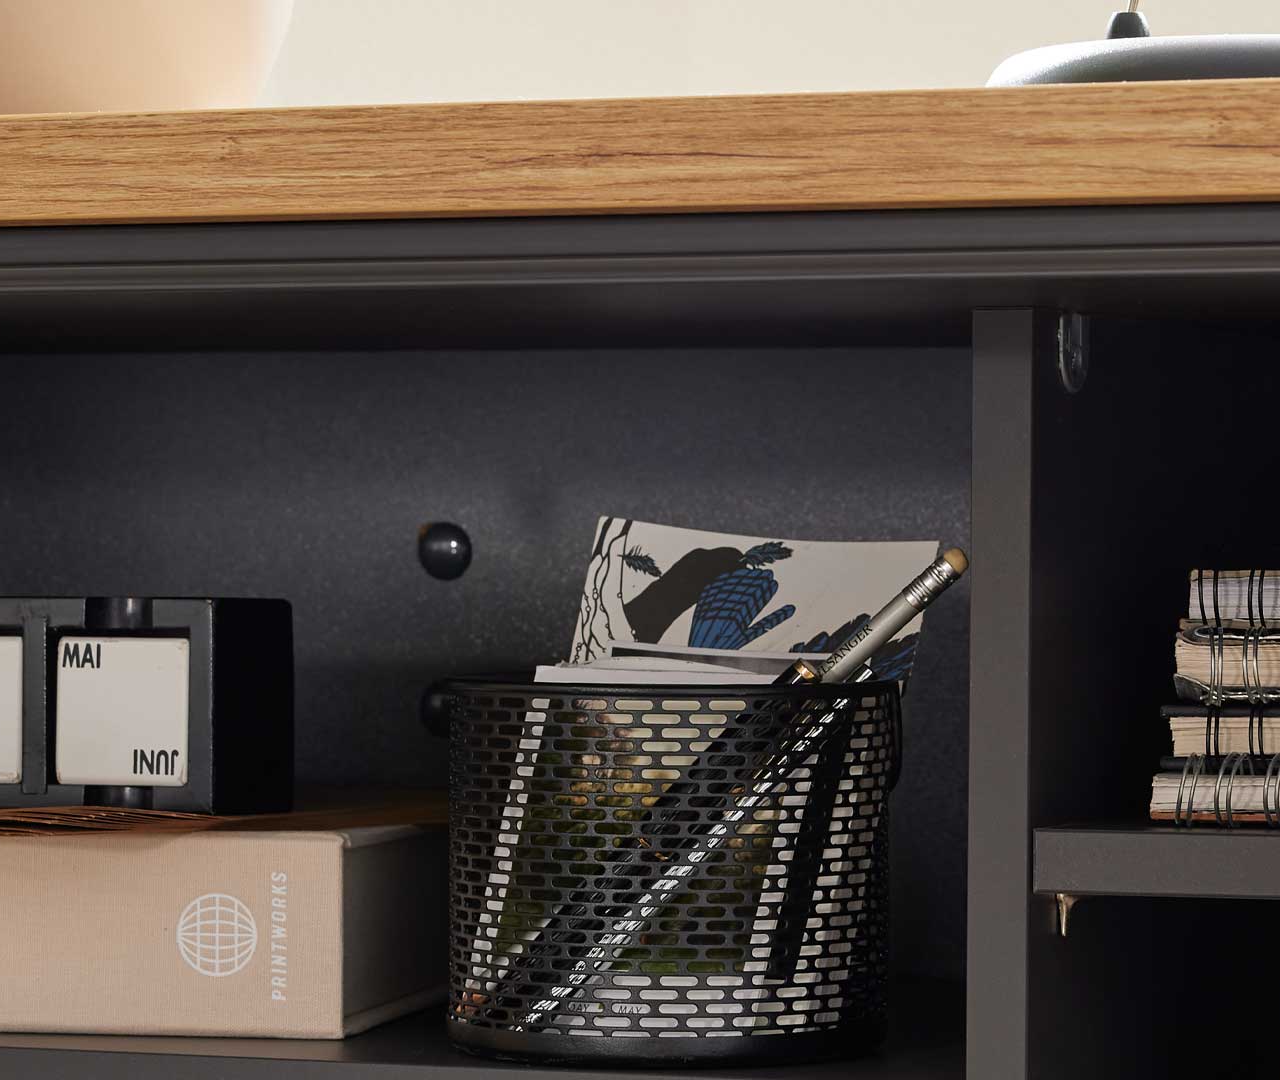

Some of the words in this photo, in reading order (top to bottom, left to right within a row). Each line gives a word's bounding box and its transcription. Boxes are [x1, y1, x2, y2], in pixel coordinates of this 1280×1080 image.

[62, 642, 102, 669] MAI
[132, 749, 180, 776] JUNI
[271, 870, 288, 1001] PRINTWORKS
